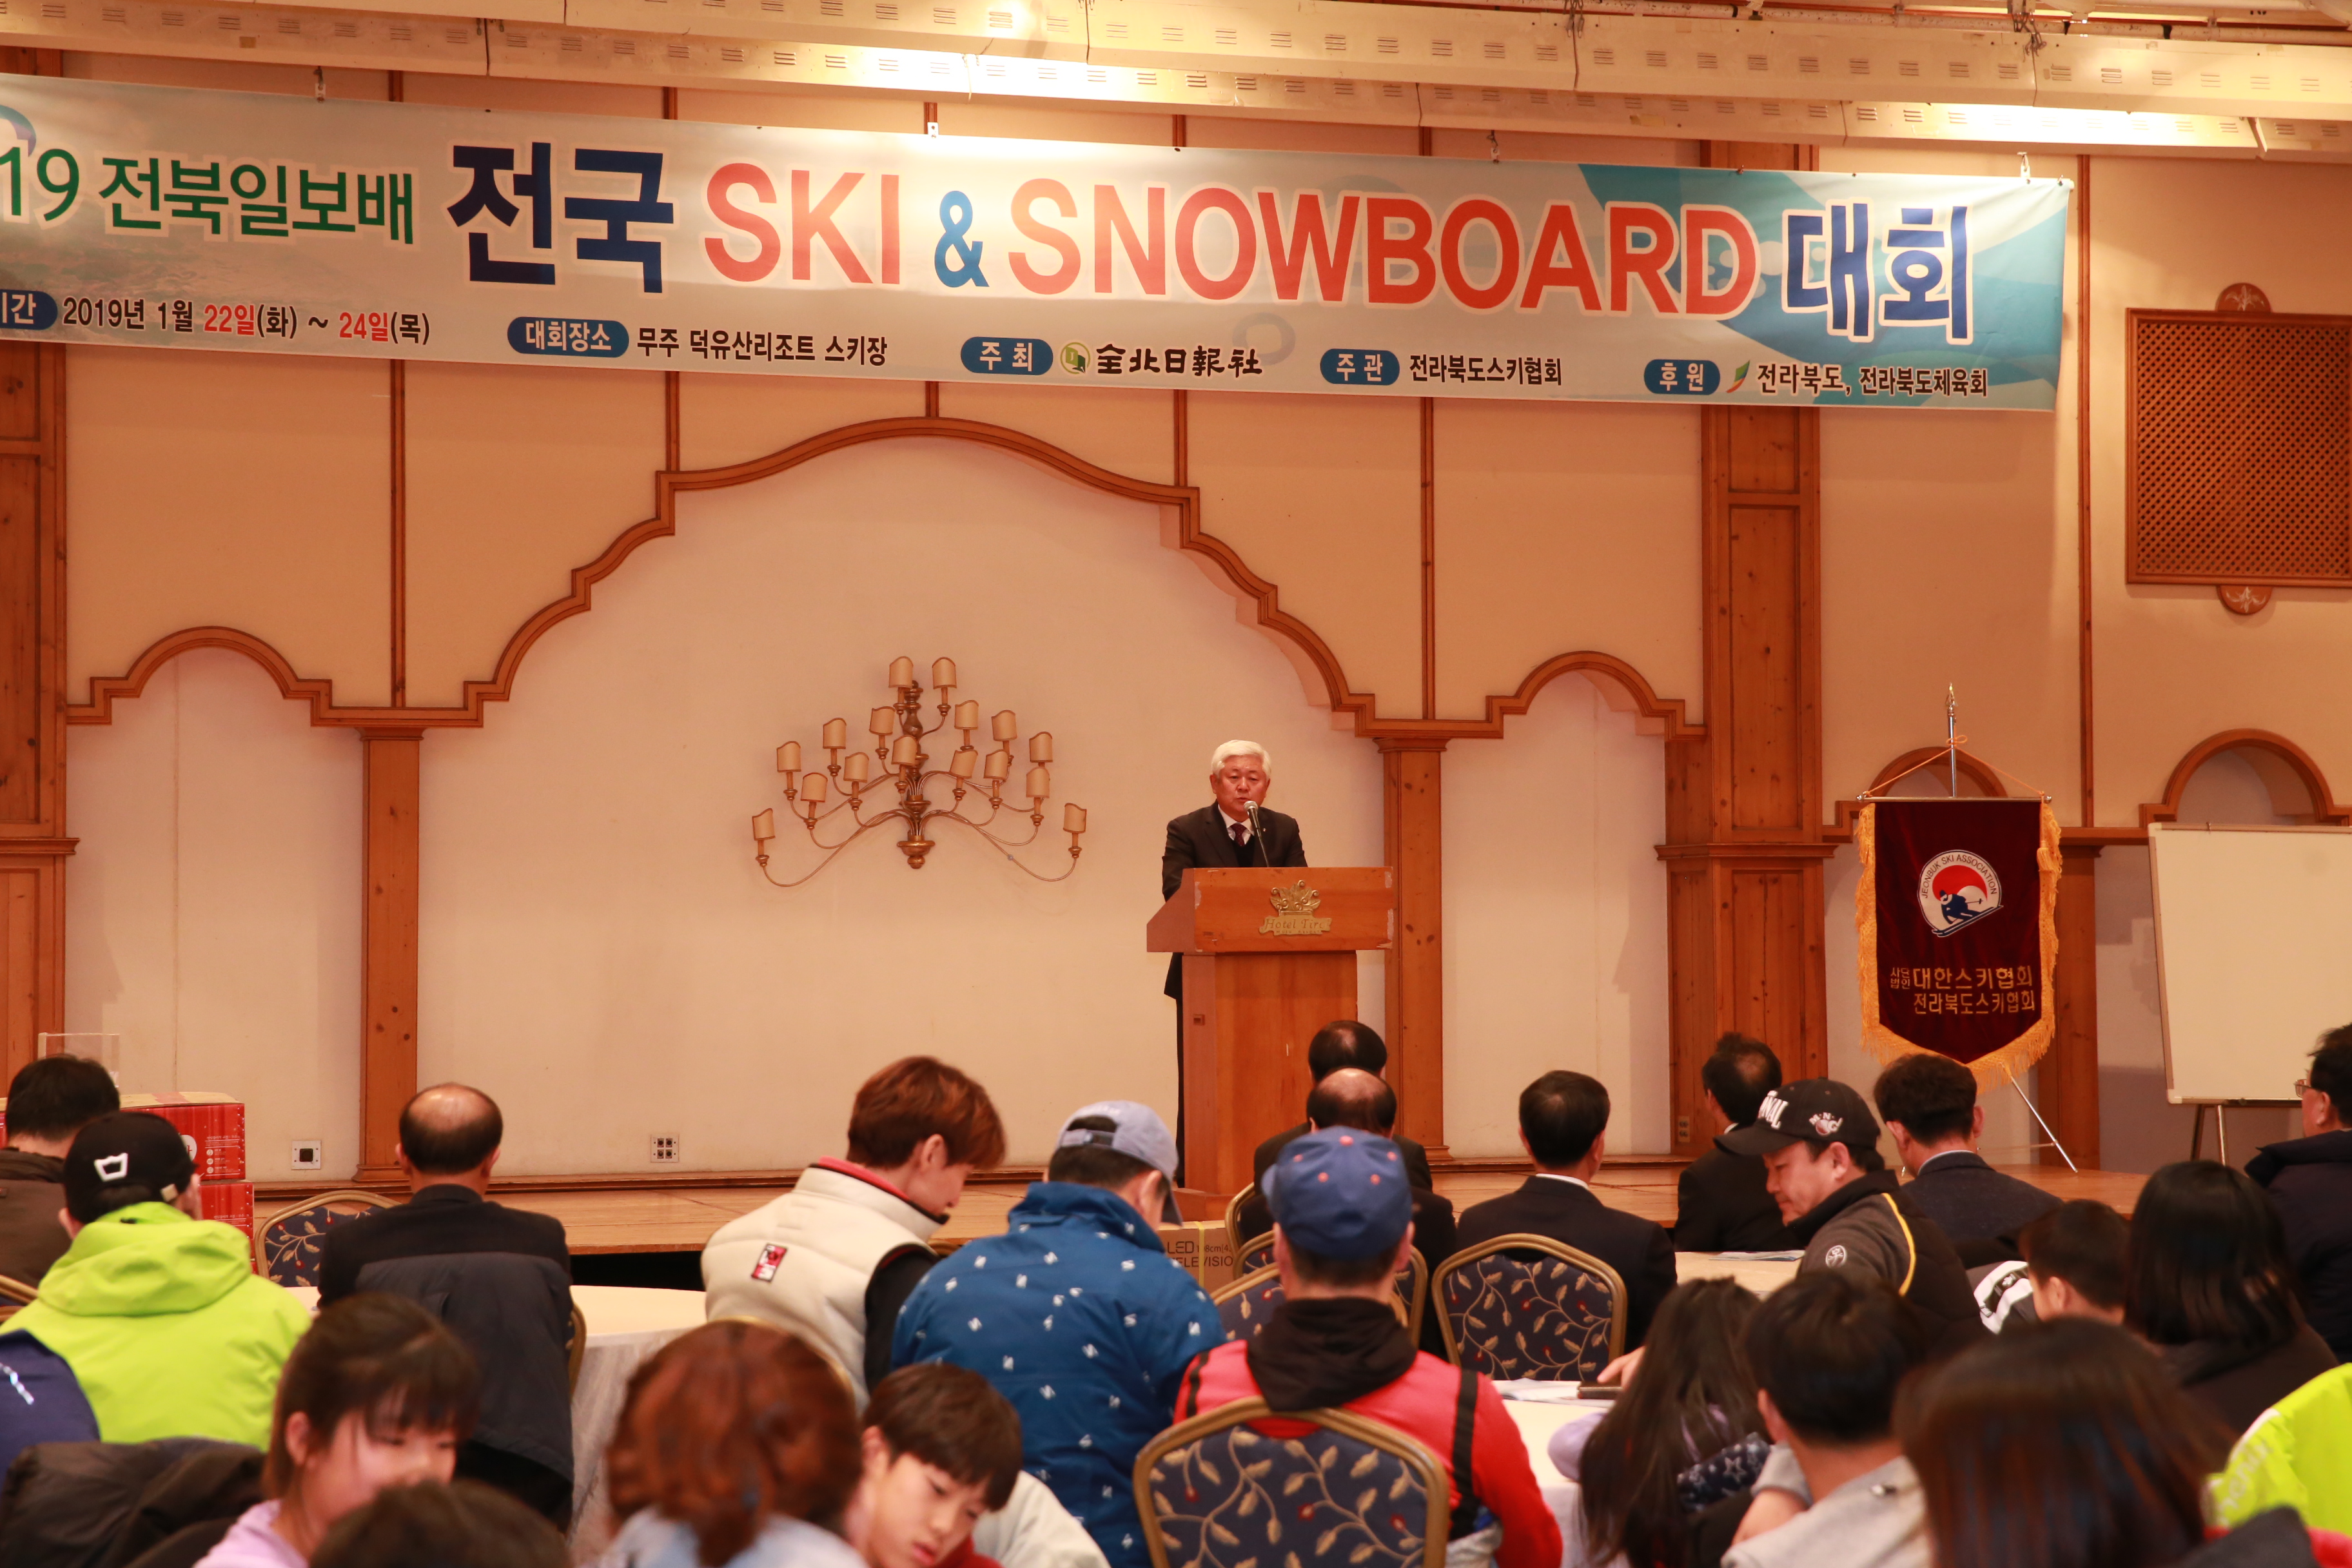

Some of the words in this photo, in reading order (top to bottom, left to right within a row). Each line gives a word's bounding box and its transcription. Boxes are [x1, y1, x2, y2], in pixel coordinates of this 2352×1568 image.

[99, 157, 414, 245] 전북일보배
[446, 141, 674, 294] 전국
[704, 162, 901, 285] SKI
[934, 190, 990, 288] &
[1008, 177, 1758, 316] SNOWBOARD
[1787, 202, 1968, 340] 대회
[63, 297, 145, 331] 2019년
[157, 299, 193, 333] 1월
[203, 304, 298, 339] 22일(화)
[338, 311, 430, 346] 24일(목)
[525, 320, 612, 352] 대회장소
[636, 326, 680, 358] 무주
[690, 329, 817, 362] 덕유산리조트
[824, 335, 888, 367] 스키장
[1095, 343, 1263, 377] 全北日報社
[1409, 353, 1563, 386] 전라북도스키협회
[1757, 362, 1852, 396] 전라북도,
[1858, 366, 1988, 397] 전라북도체육회
[1921, 861, 1941, 899] JEONBUK
[1941, 854, 1954, 865] SKI
[1956, 854, 1998, 895] ASSOCIATION
[1264, 917, 1296, 930] Hotel
[1913, 965, 2033, 989] 대한스키협회
[1914, 990, 2035, 1015] 전라북도스키협회
[1167, 1240, 1195, 1254] LED
